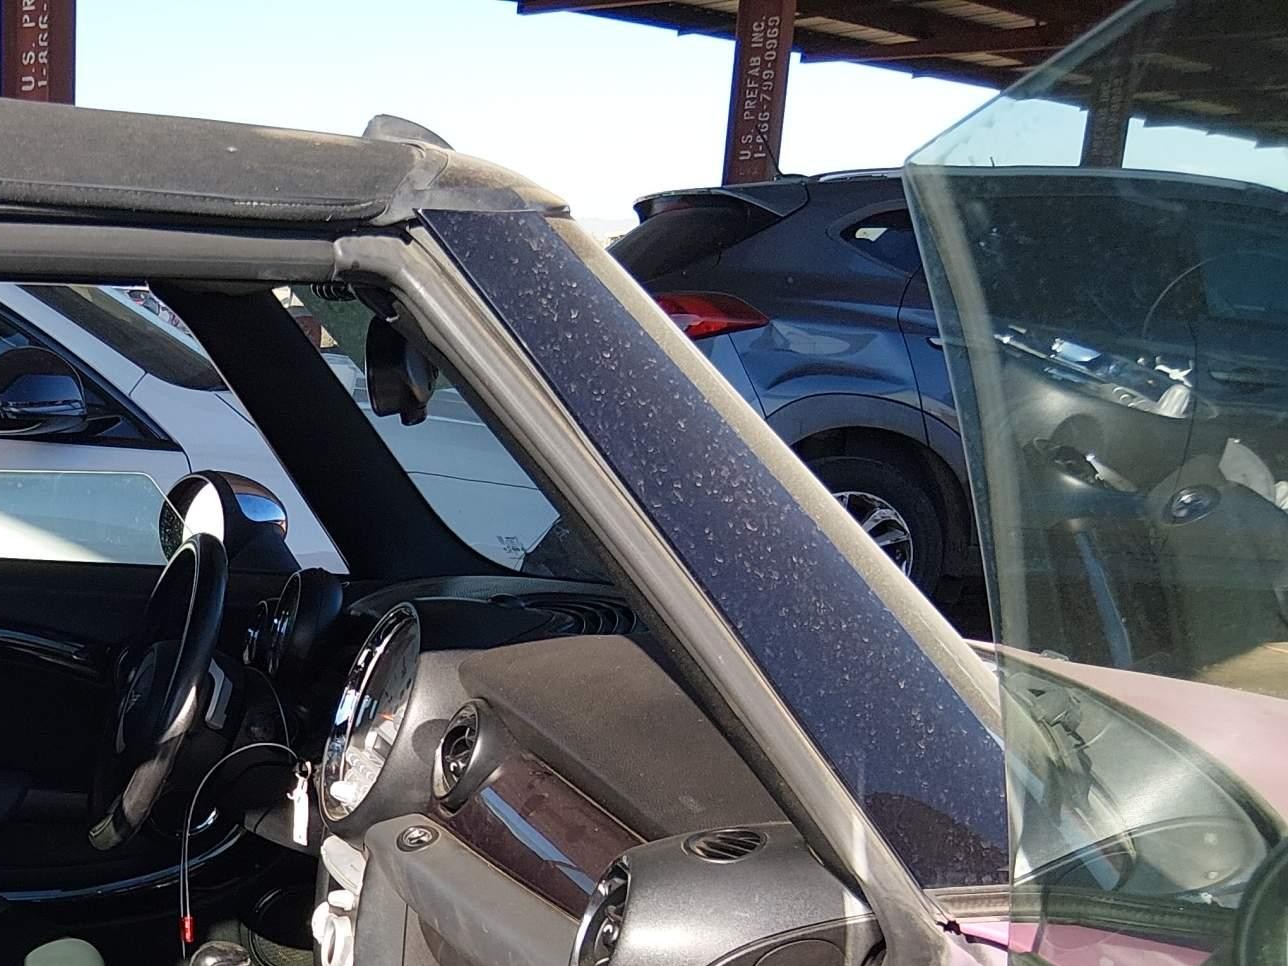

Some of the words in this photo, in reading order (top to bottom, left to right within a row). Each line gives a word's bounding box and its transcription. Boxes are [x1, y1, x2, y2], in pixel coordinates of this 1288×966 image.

[751, 16, 766, 48] INC.
[22, 43, 36, 91] U.S.
[743, 55, 762, 120] PREFAB
[738, 128, 754, 160] U.S.
